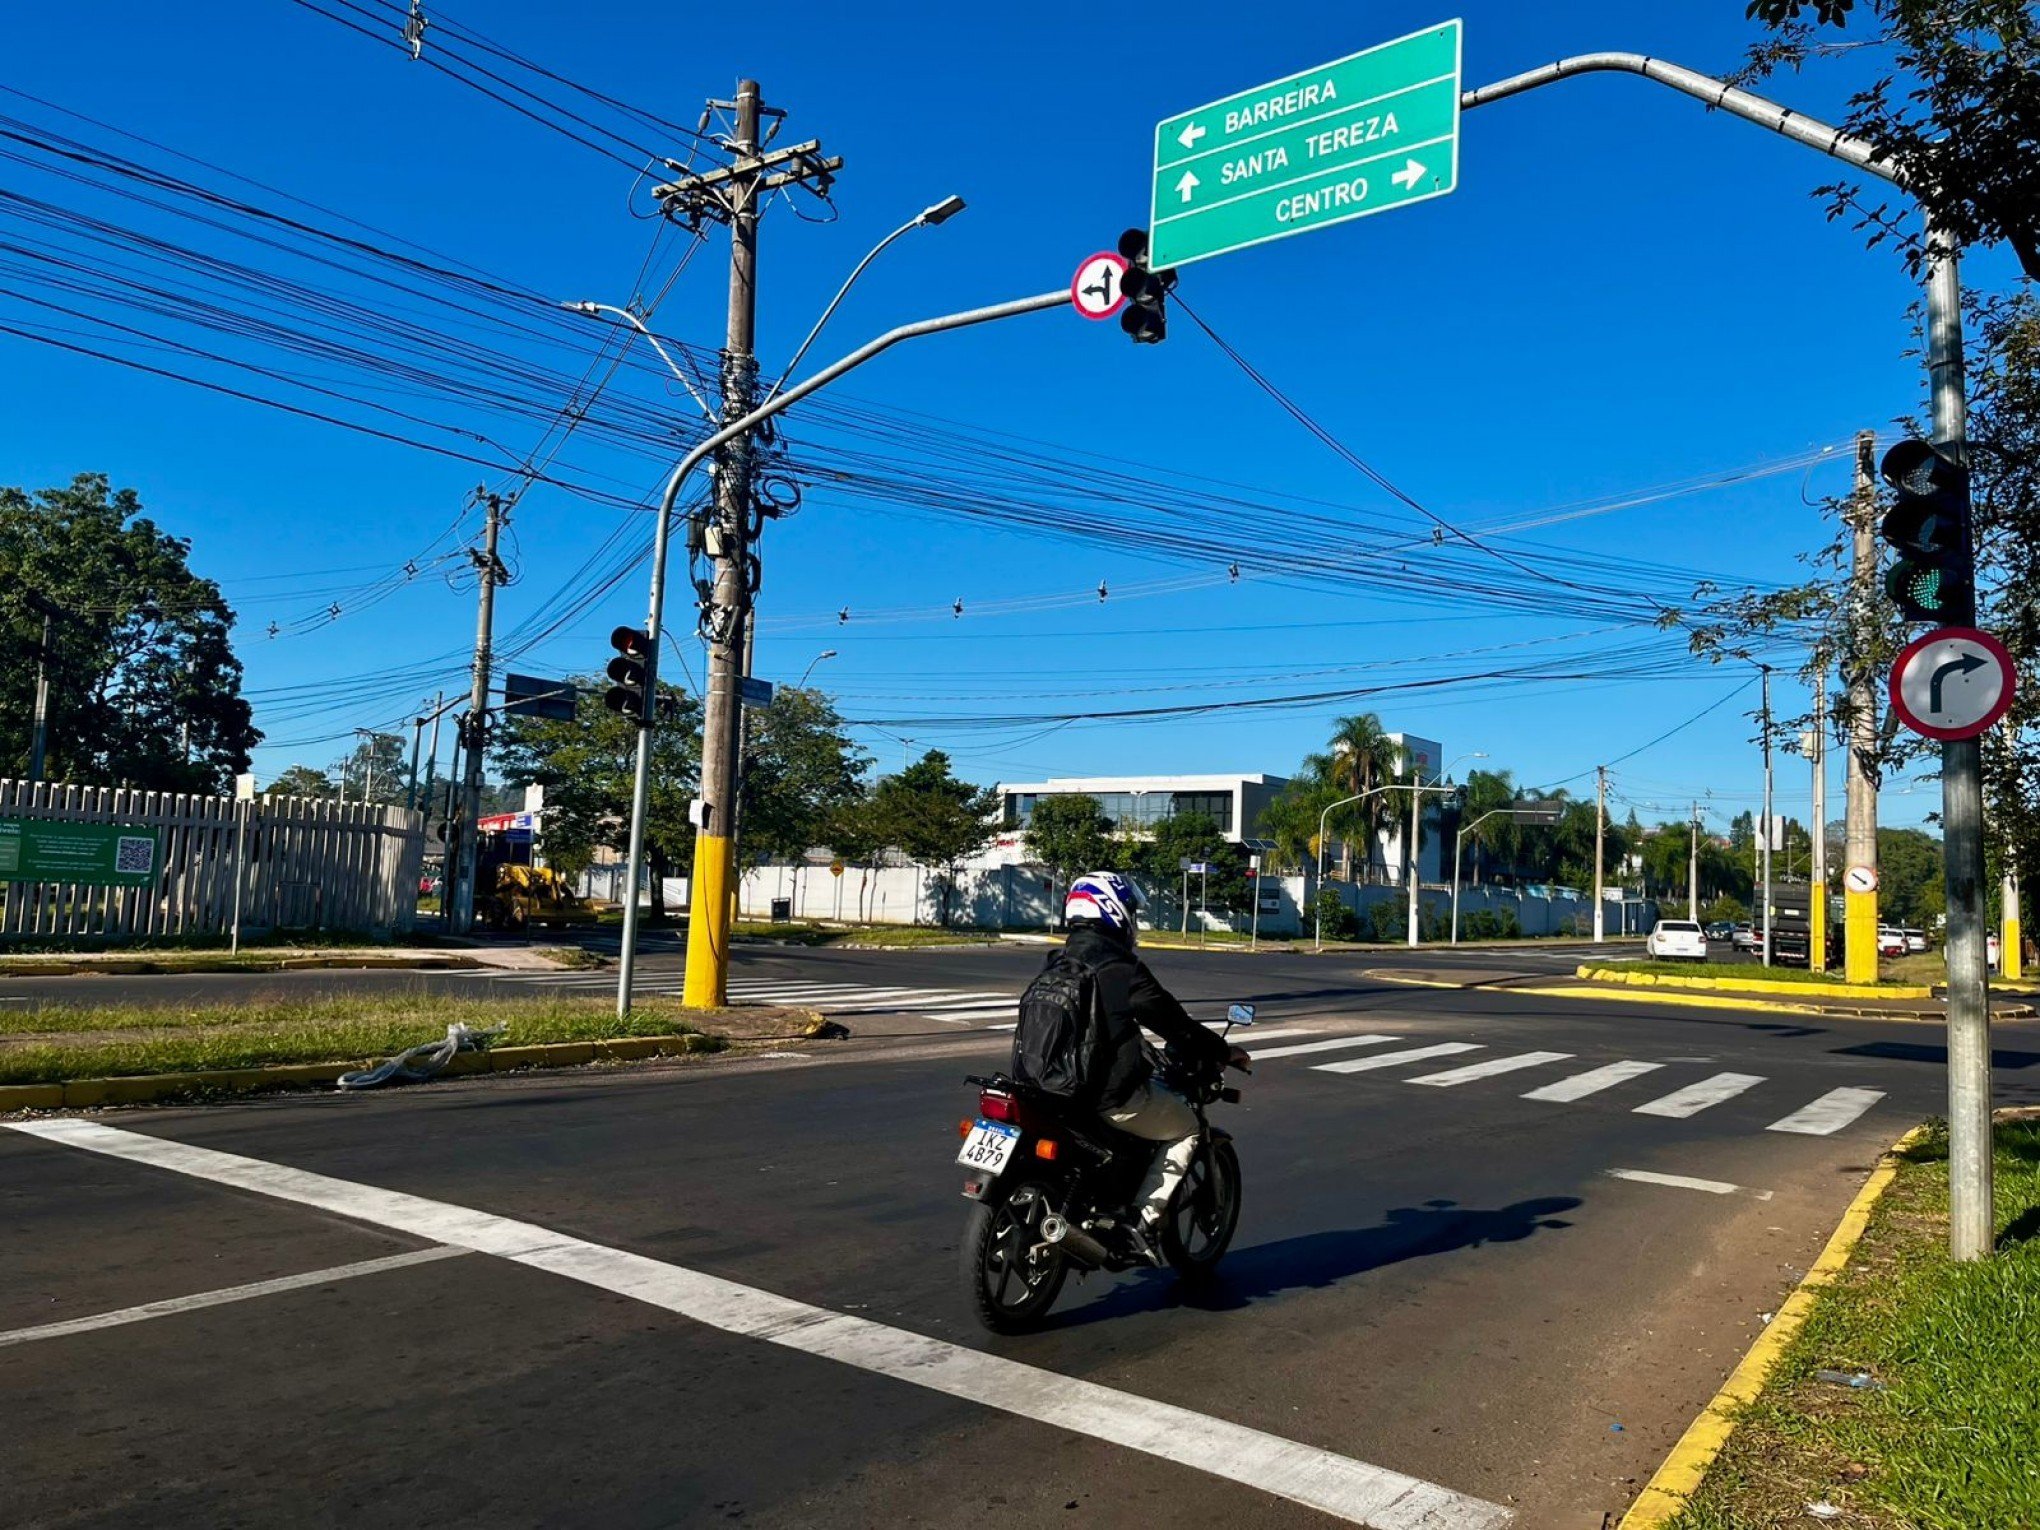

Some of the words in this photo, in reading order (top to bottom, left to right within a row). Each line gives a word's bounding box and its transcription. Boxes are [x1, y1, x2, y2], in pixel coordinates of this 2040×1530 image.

[1225, 79, 1337, 134] BARREIRA
[1221, 147, 1289, 184] SANTA
[1305, 112, 1399, 158] TEREZA
[1275, 178, 1368, 222] CENTRO
[966, 1144, 1003, 1167] 4B79
